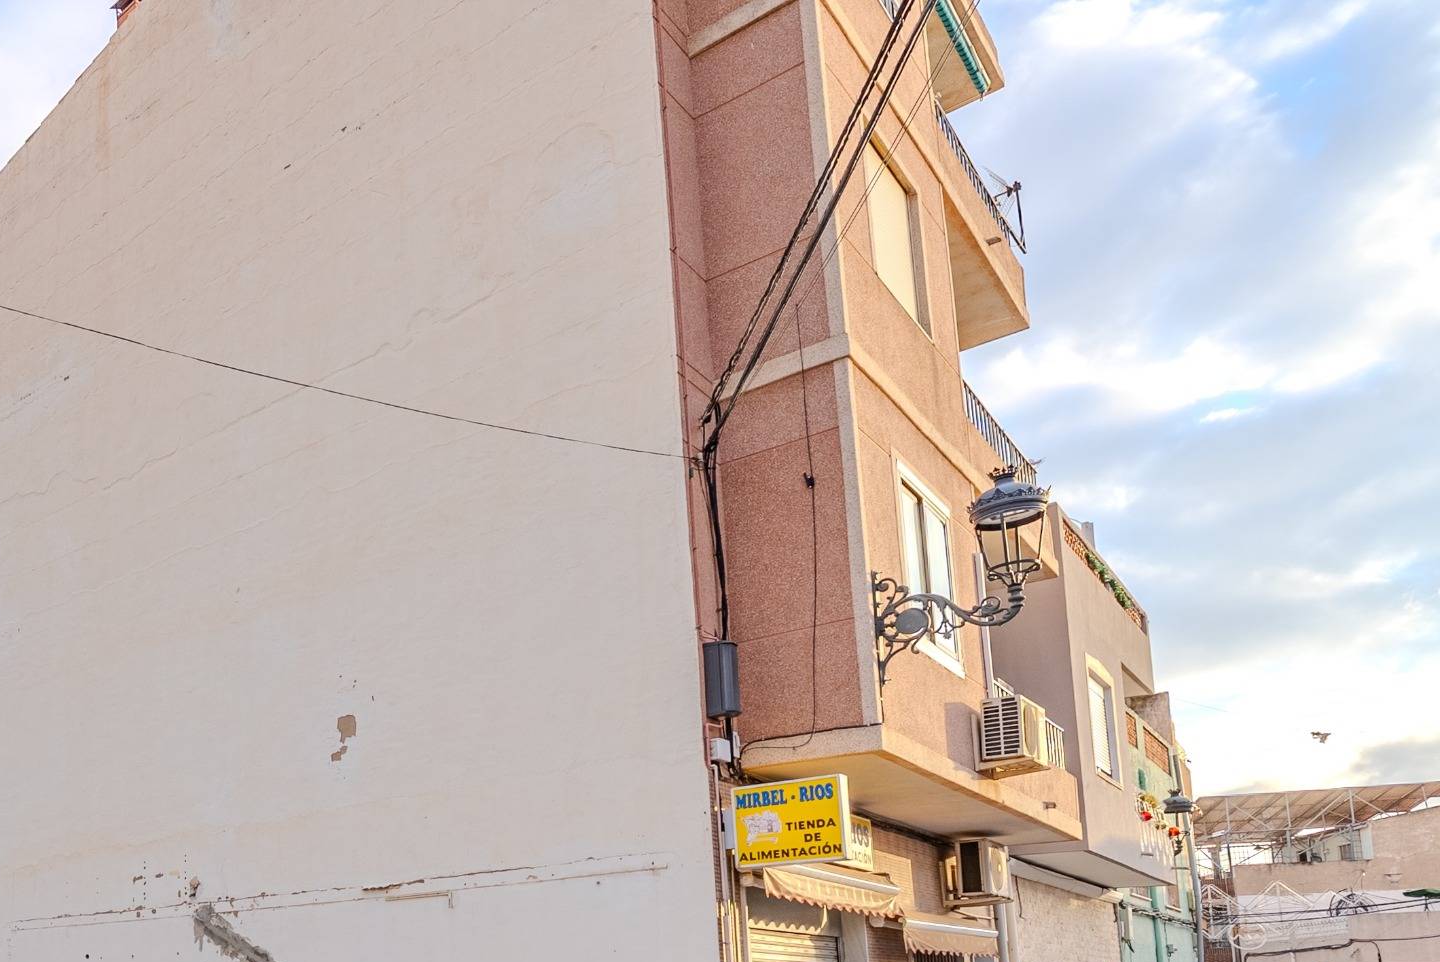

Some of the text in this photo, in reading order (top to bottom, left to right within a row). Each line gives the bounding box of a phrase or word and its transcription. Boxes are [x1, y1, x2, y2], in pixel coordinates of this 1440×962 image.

[736, 788, 787, 809] MIRBEL
[799, 782, 834, 802] RIOS
[785, 818, 836, 831] TIENDA
[804, 832, 822, 843] DE
[739, 842, 842, 862] ALIMENTACIÓN
